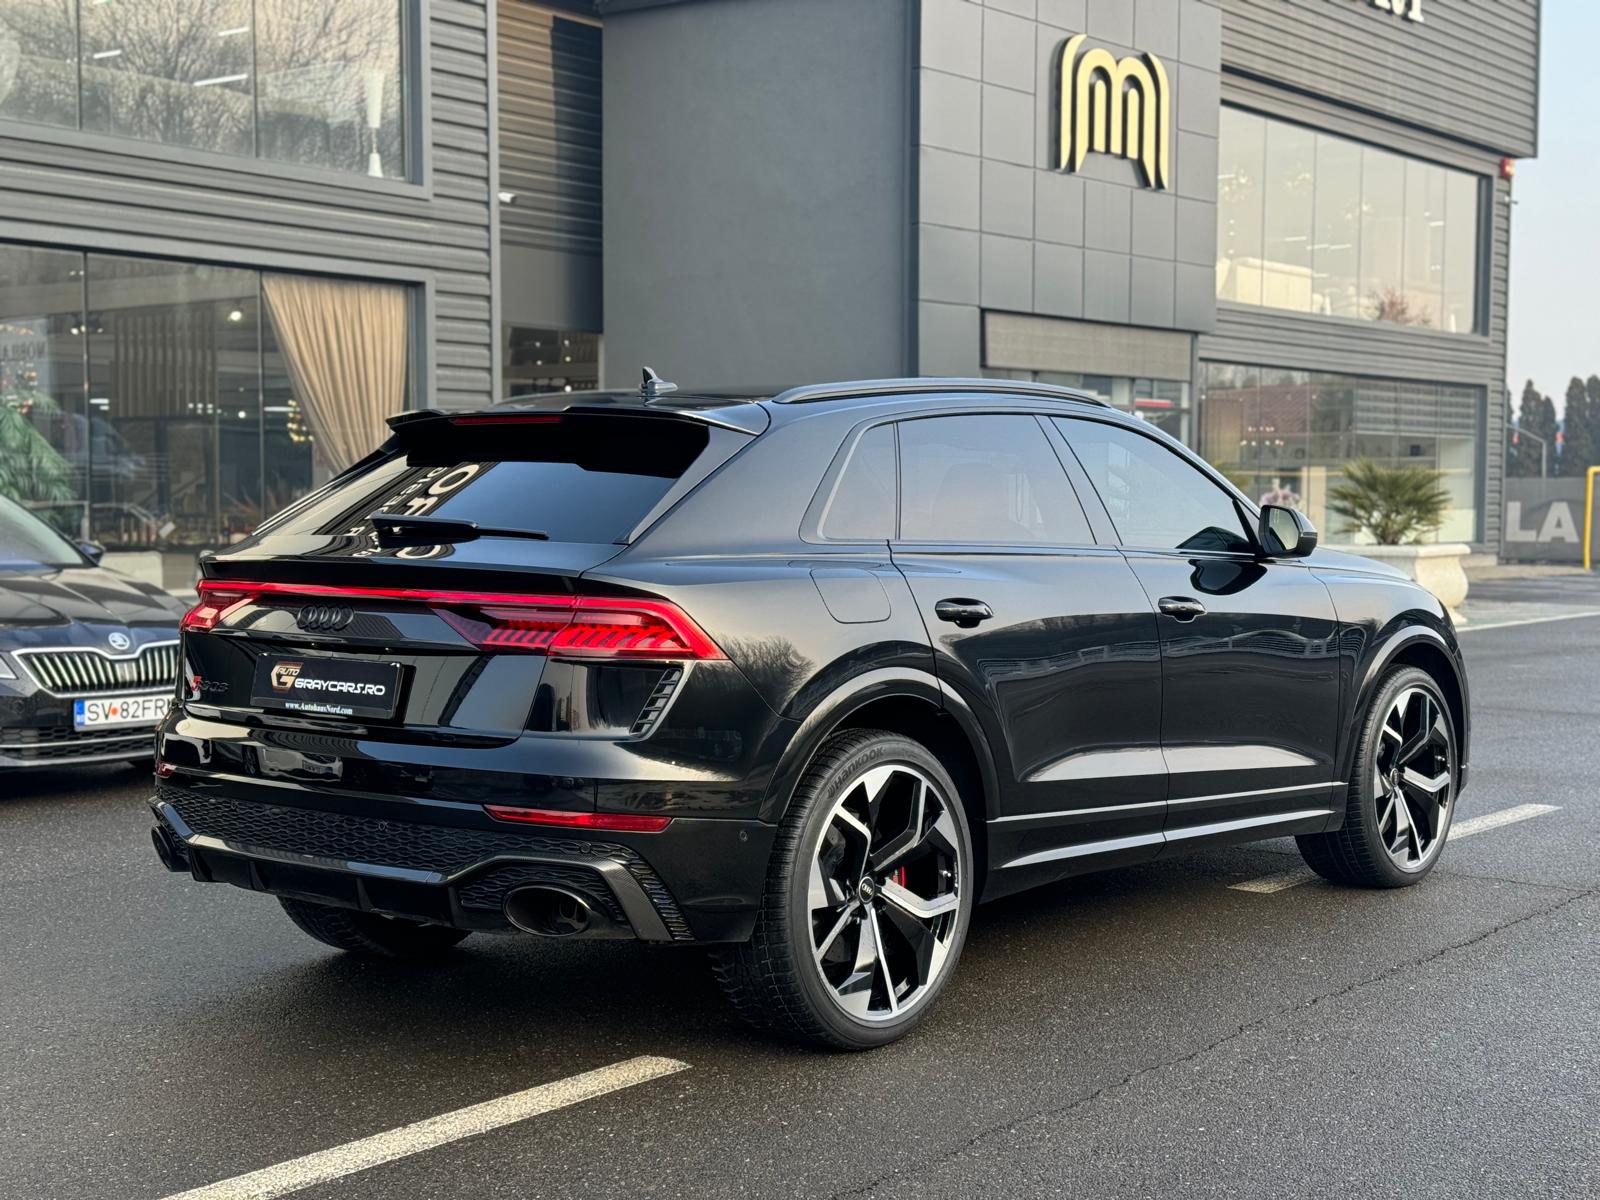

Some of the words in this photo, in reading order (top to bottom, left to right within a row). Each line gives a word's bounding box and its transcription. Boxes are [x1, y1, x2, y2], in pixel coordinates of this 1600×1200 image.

[276, 666, 301, 676] AUTO
[294, 677, 386, 696] GRAYCARS.RO
[87, 702, 112, 721] SV
[284, 701, 354, 715] www.AutohausNord.com
